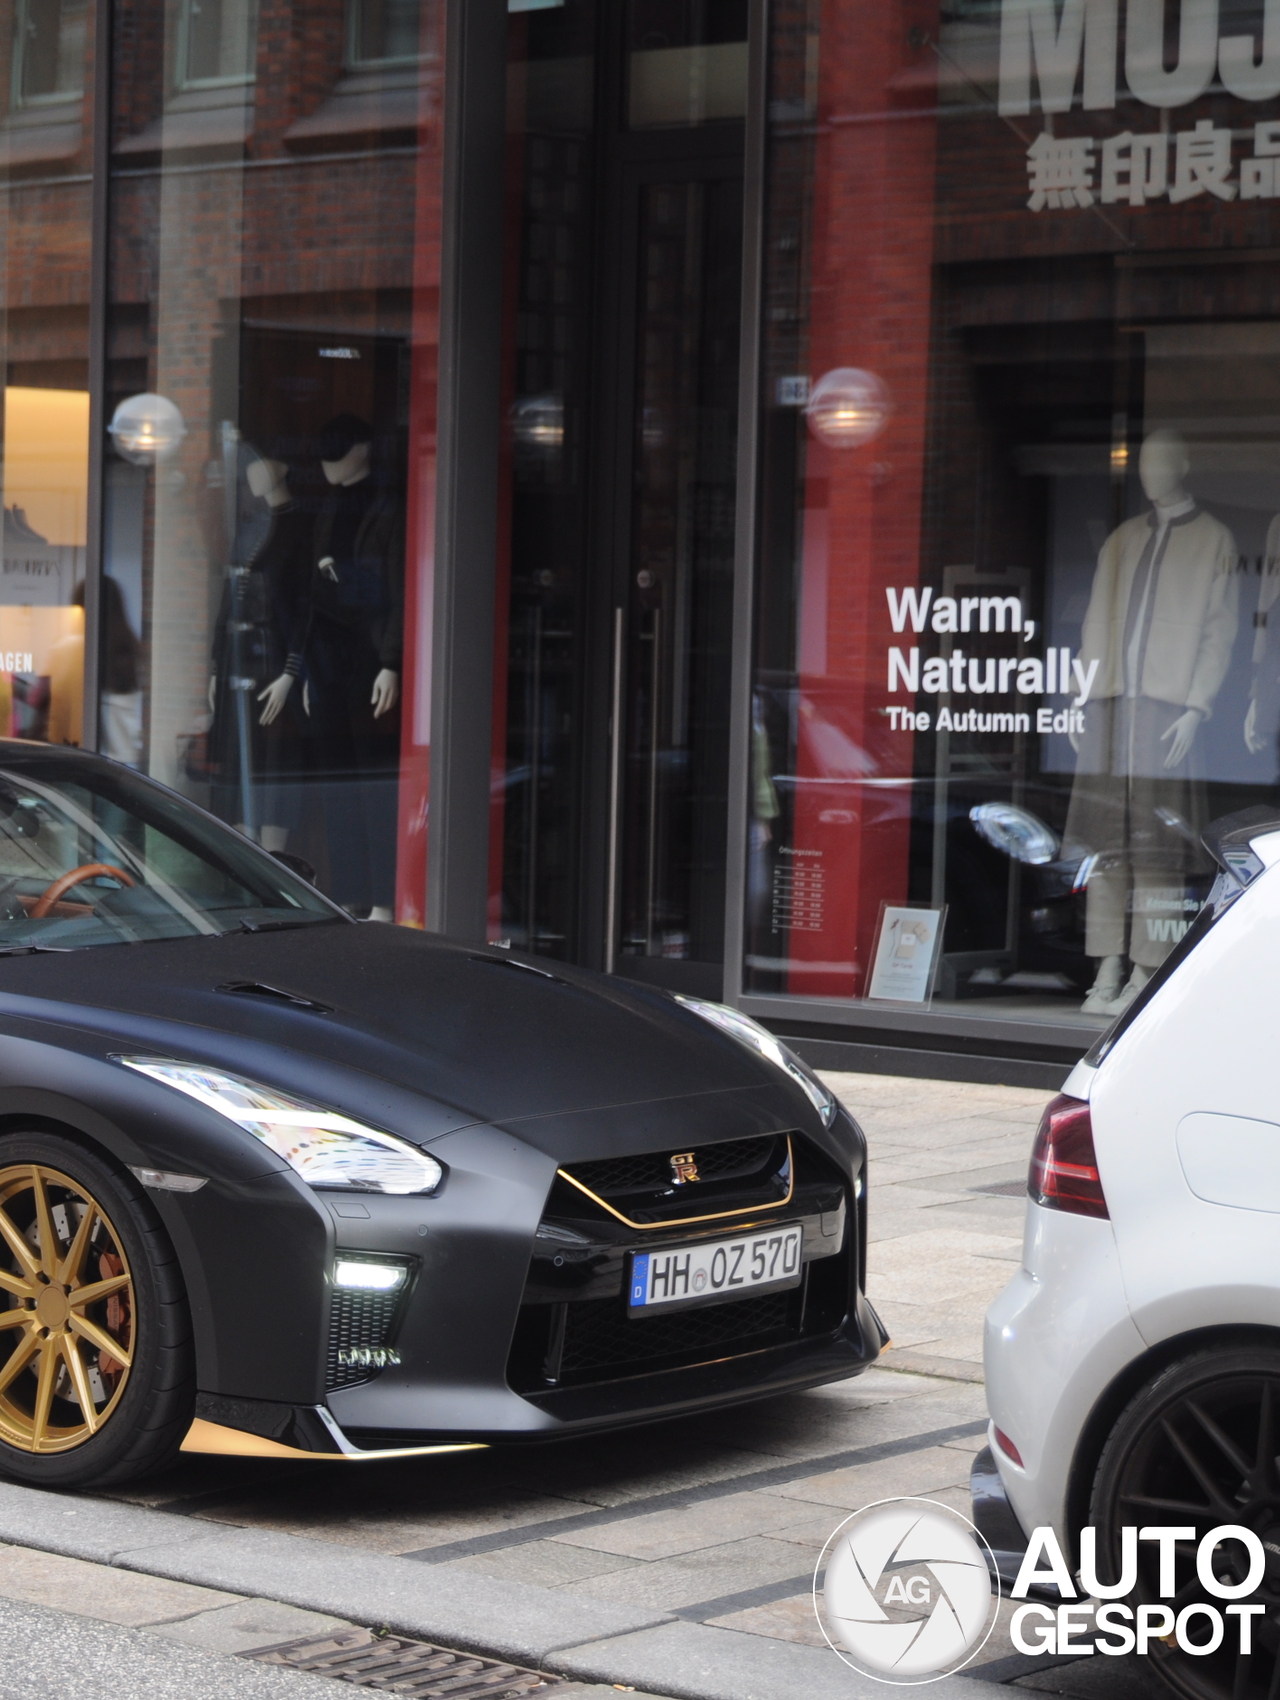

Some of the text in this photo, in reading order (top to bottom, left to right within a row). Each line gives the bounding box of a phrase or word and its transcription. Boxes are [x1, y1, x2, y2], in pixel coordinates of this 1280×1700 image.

[885, 586, 1036, 641] Warm,
[887, 646, 1100, 707] Naturally
[885, 706, 1086, 734] The Autumn Edit
[1183, 898, 1199, 912] Sie
[649, 1233, 799, 1299] HH OZ 570
[633, 1285, 642, 1299] D
